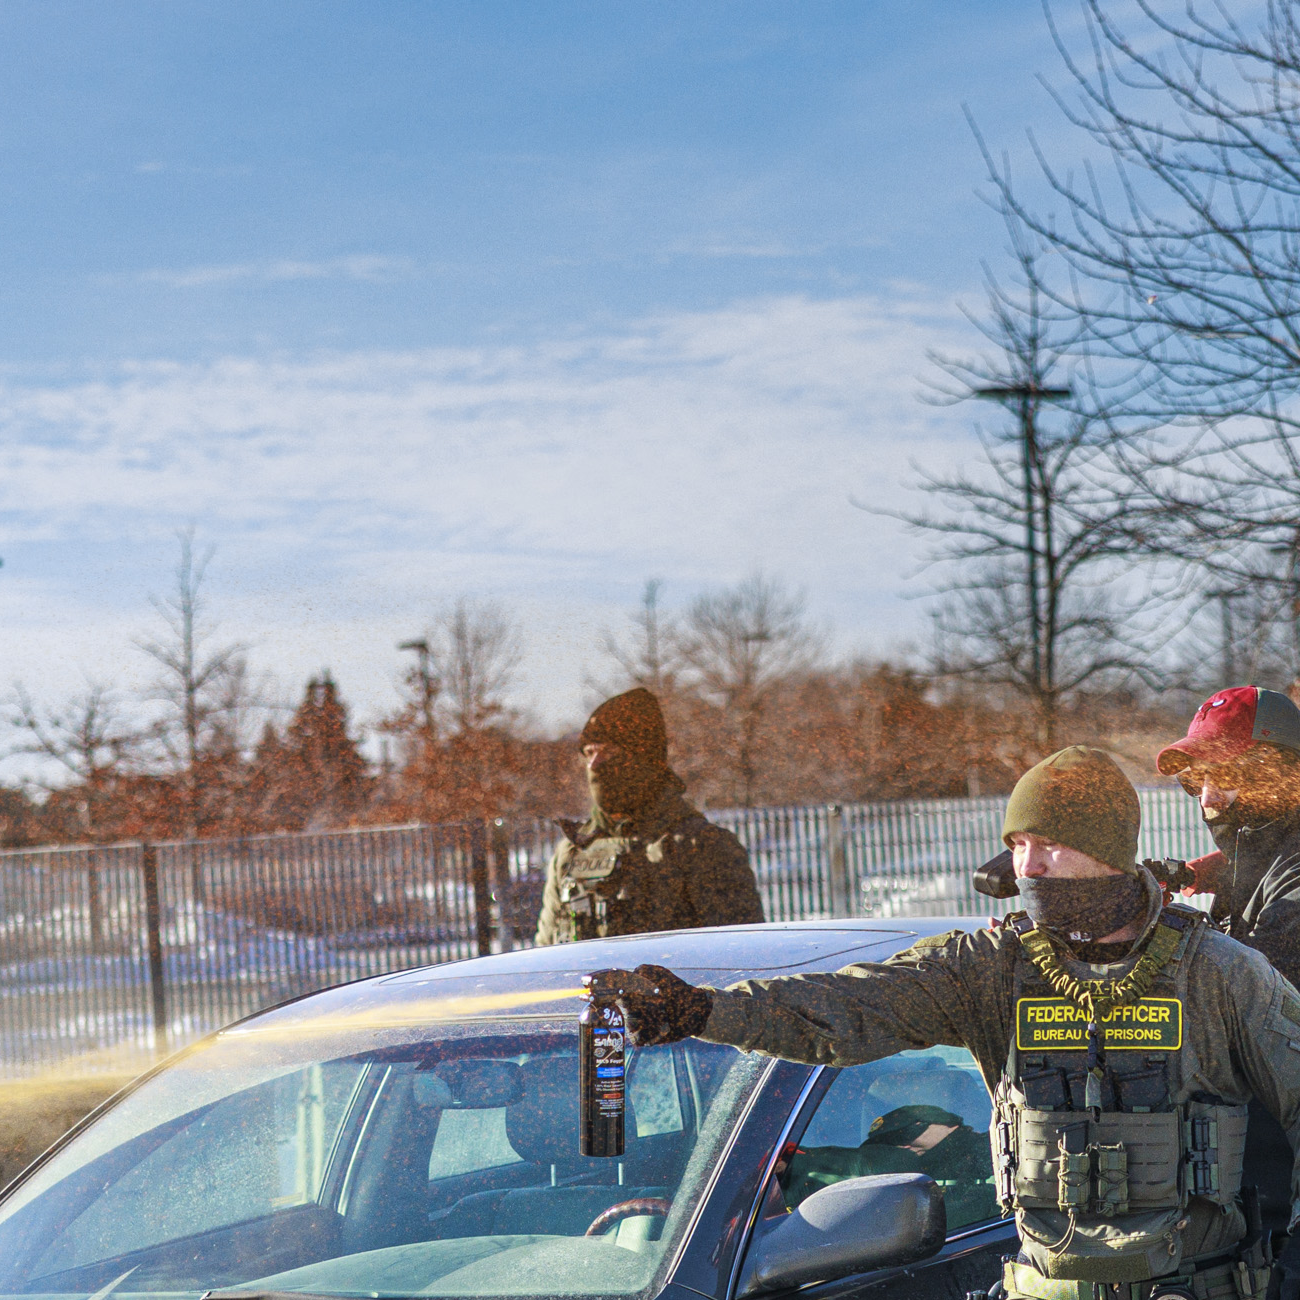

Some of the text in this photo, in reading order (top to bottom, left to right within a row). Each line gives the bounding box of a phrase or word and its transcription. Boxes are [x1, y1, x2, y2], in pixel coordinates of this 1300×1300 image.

[1027, 1006, 1093, 1023] FEDERAL
[1033, 1029, 1082, 1041] BUREAU
[1105, 1029, 1162, 1041] PRISONS
